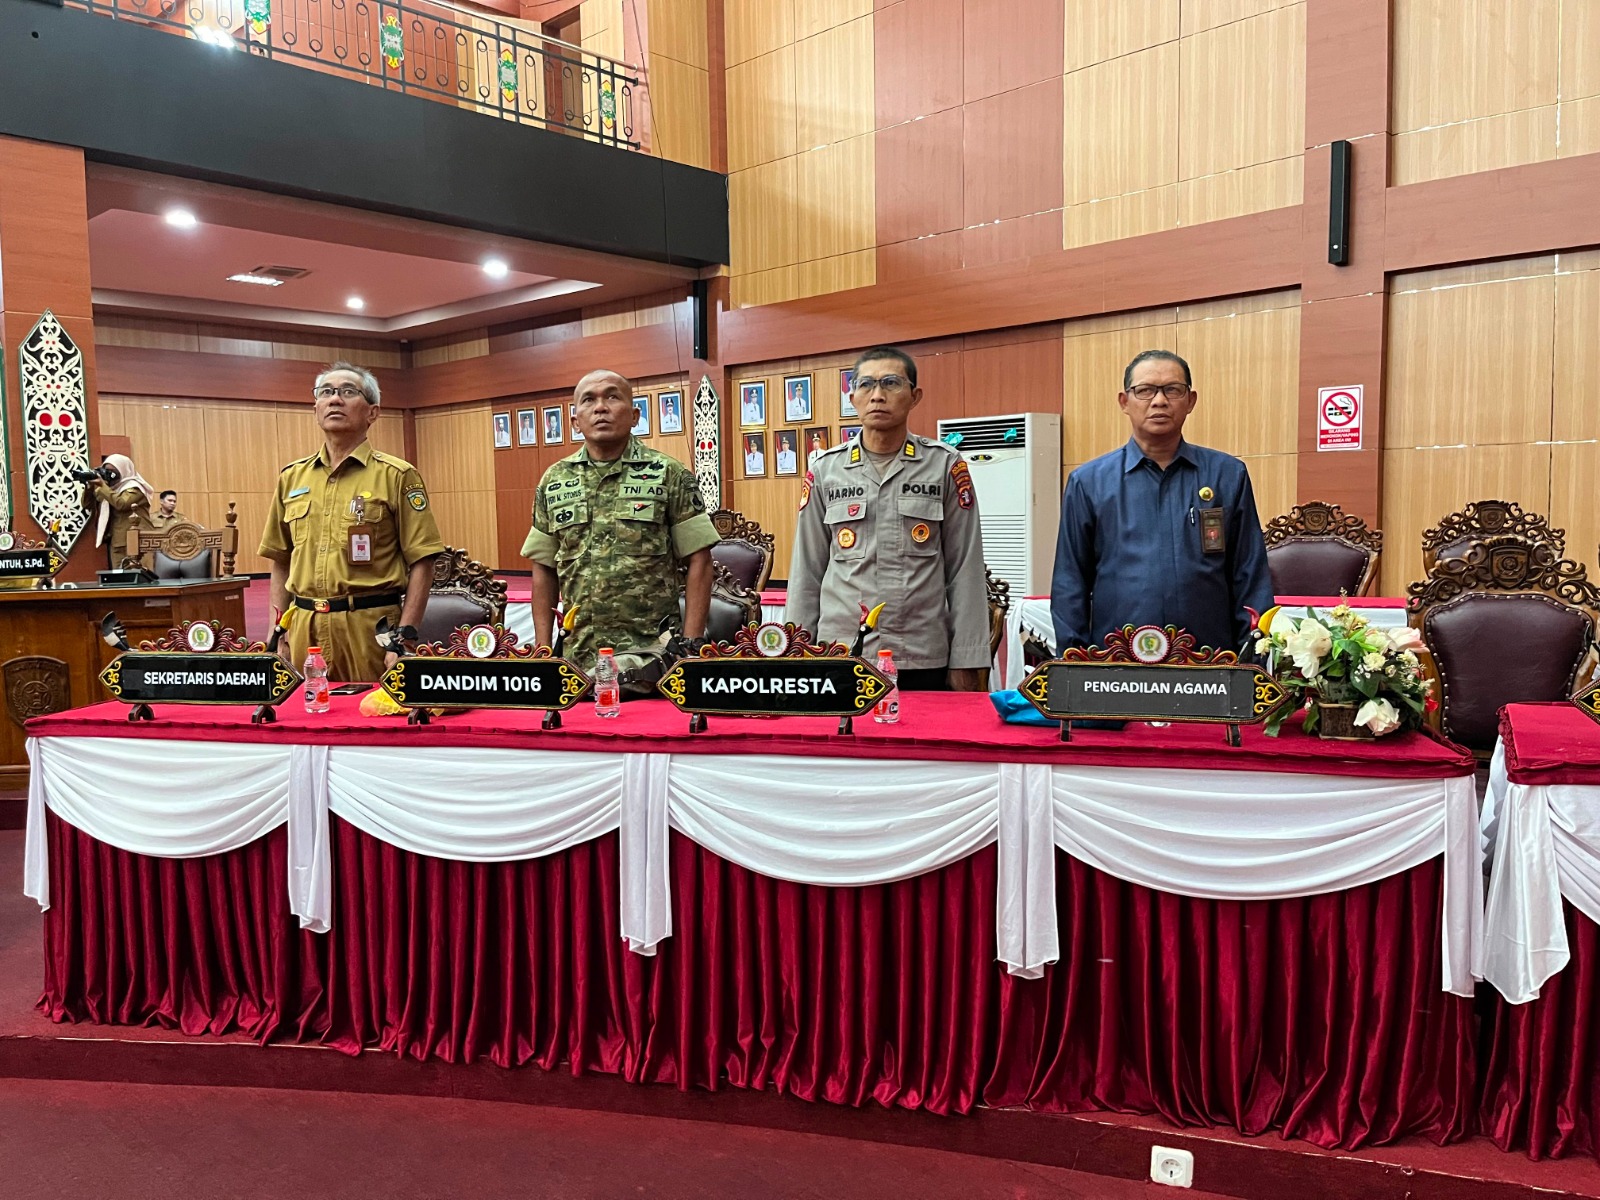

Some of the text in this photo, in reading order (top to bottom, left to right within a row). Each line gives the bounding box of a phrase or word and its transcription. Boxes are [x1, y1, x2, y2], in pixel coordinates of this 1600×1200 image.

[623, 486, 664, 496] TNI AD
[828, 486, 864, 501] HARNO
[902, 483, 941, 497] POLRI
[25, 558, 45, 568] S.Pd.
[143, 671, 266, 686] SEKRETARIS DAERAH
[420, 674, 542, 692] DANDIM 1016
[701, 677, 837, 694] KAPOLRESTA
[1084, 681, 1228, 695] PENGADILAN AGAMA
